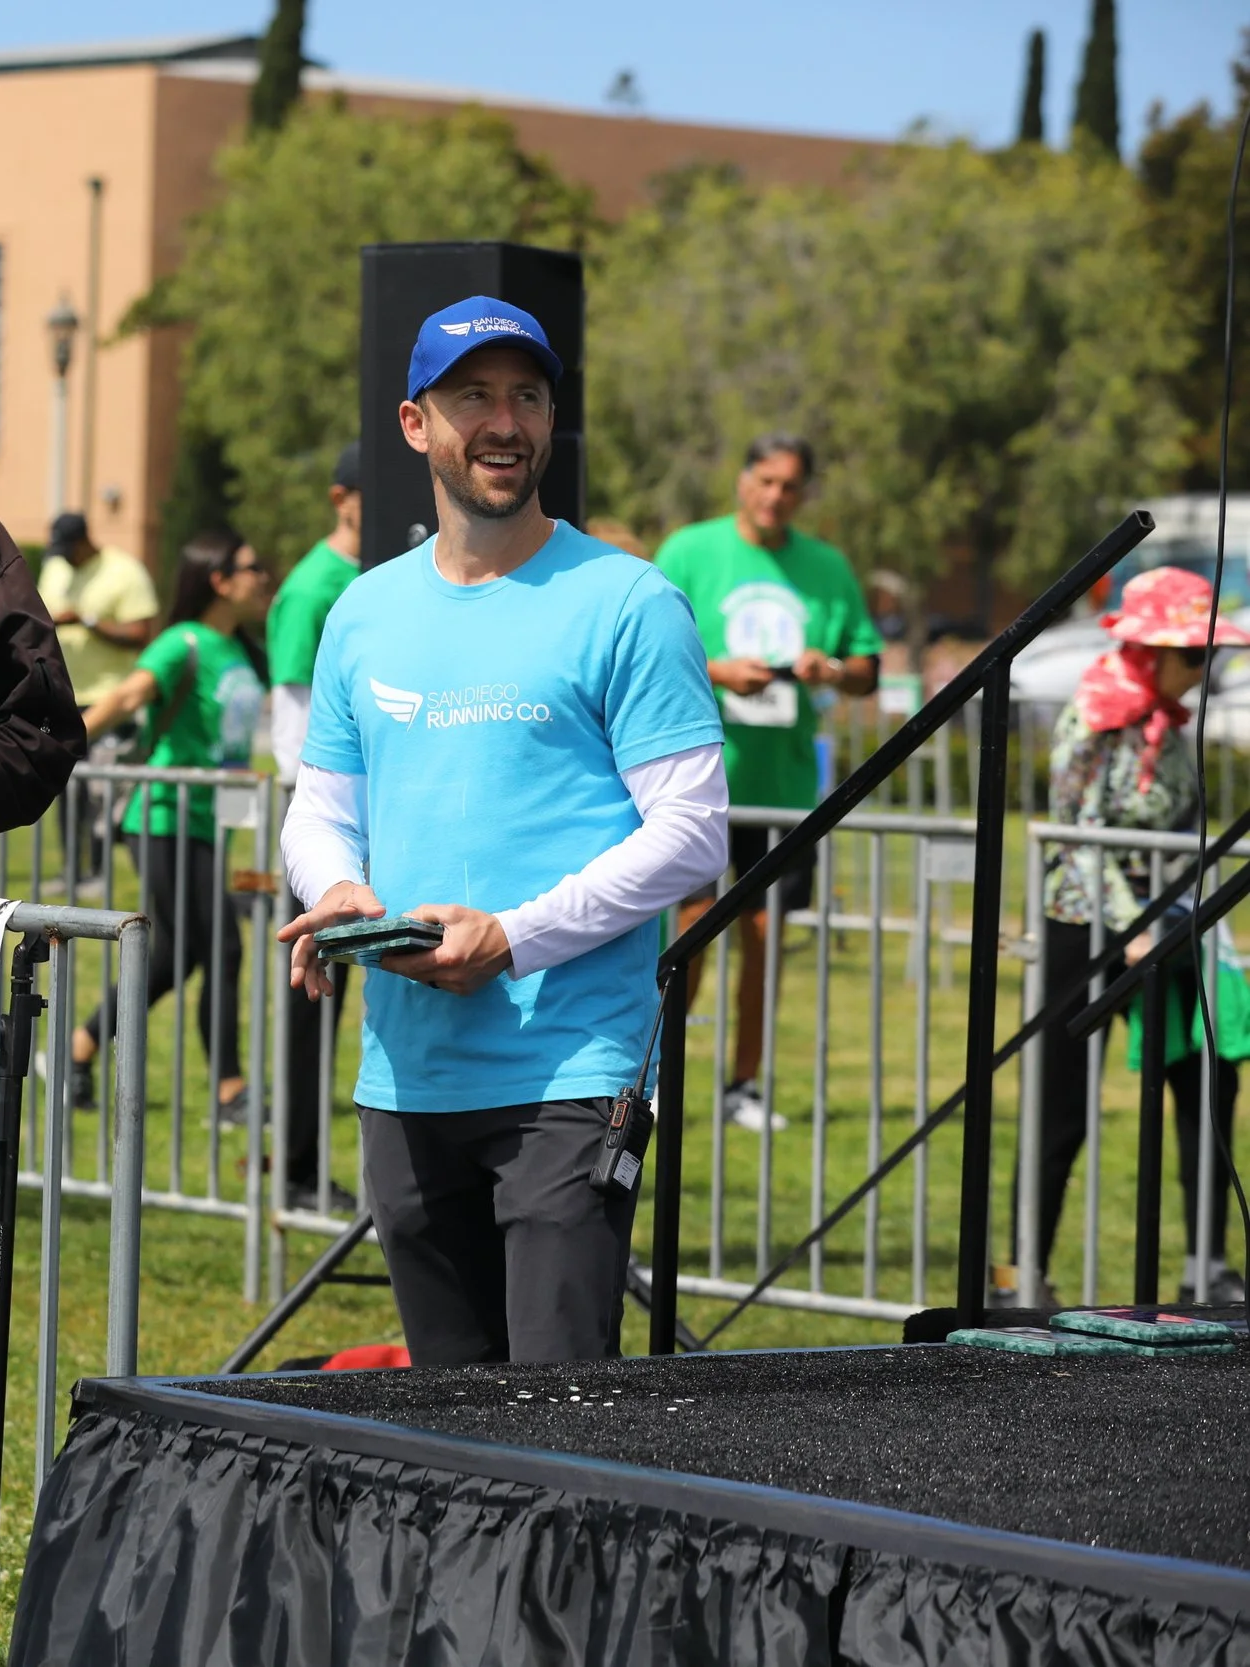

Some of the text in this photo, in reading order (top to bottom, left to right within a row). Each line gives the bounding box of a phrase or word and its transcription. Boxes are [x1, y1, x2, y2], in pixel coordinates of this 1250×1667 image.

[472, 316, 521, 329] SAN DIEGO
[475, 326, 520, 335] RUNNING
[427, 683, 519, 709] SAN DIEGO
[427, 703, 553, 729] RUNNING CO.
